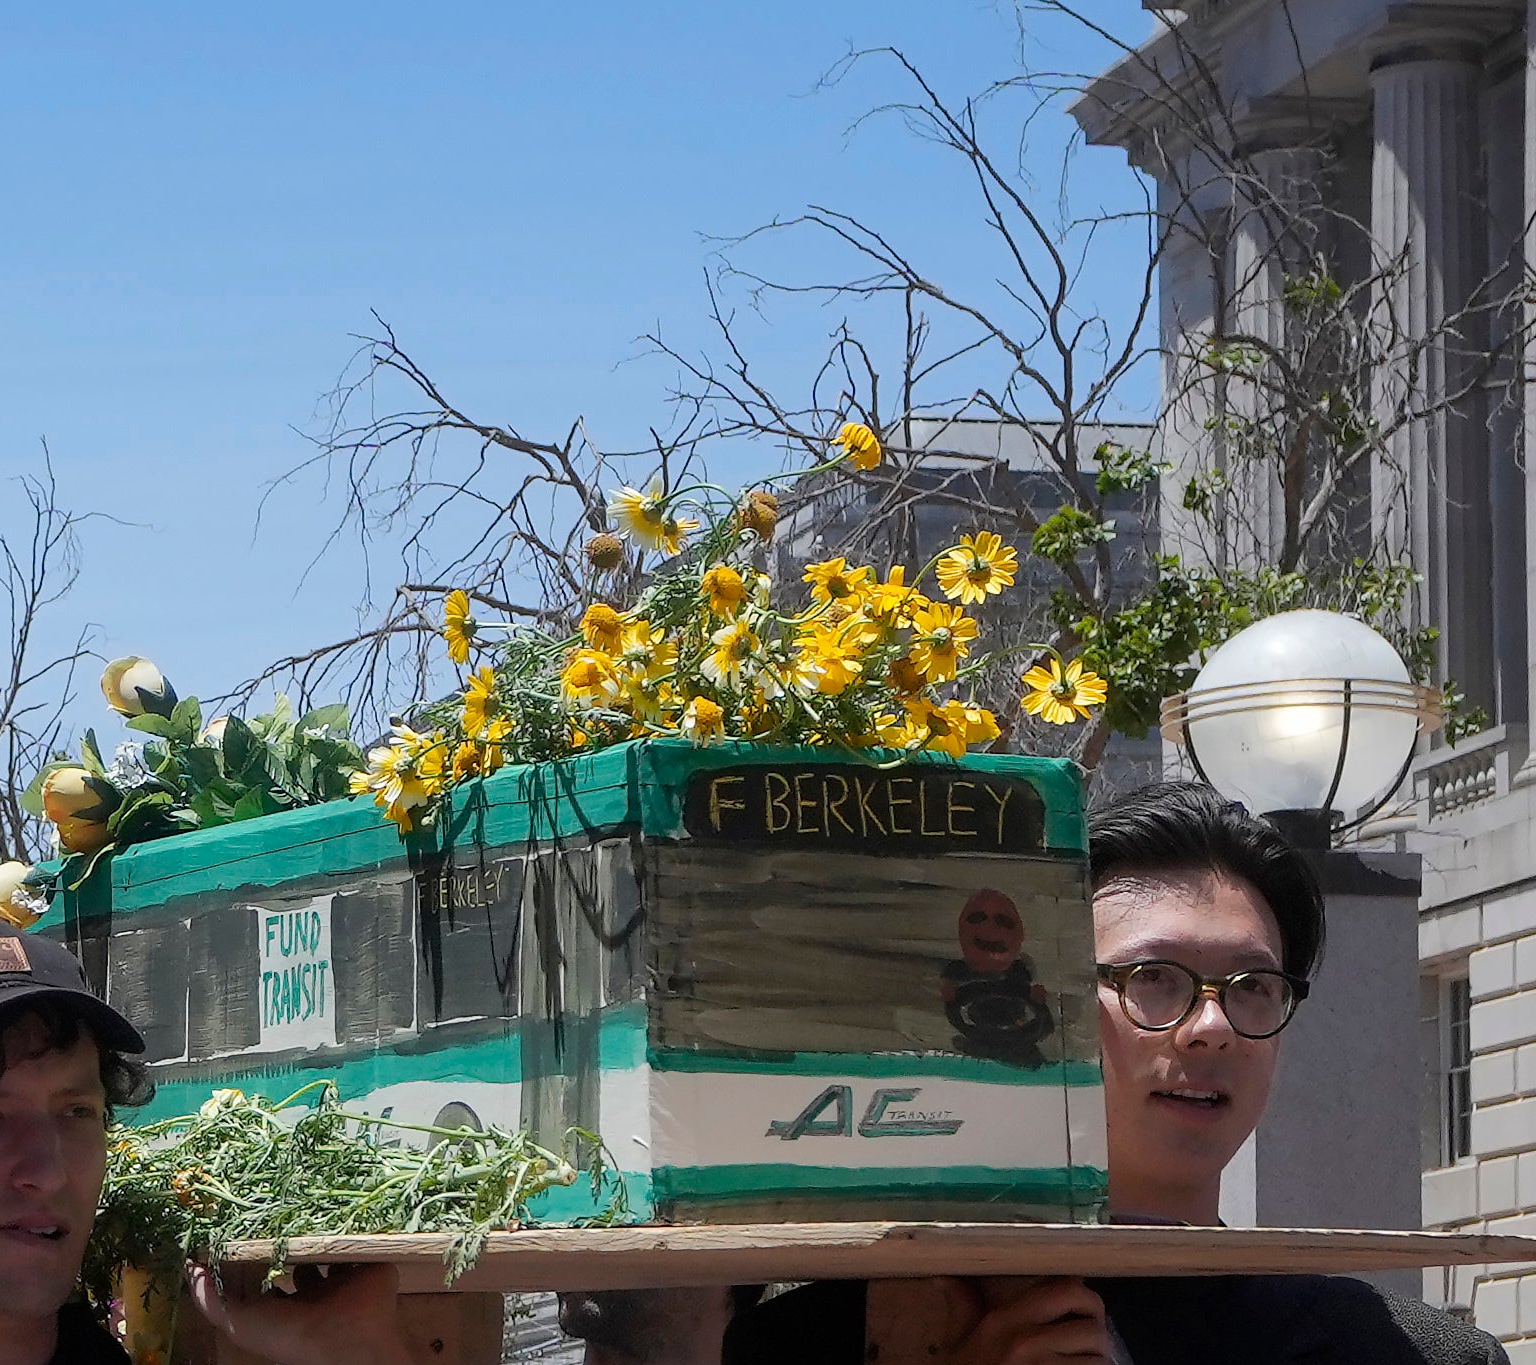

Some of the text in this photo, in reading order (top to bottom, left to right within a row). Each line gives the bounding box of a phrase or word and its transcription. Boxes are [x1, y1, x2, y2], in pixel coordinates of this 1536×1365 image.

[709, 773, 1013, 846] F BERKELEY
[265, 911, 321, 957] FUND
[263, 960, 329, 1028] TRANSIT
[764, 1084, 965, 1141] AC TRANSIT
